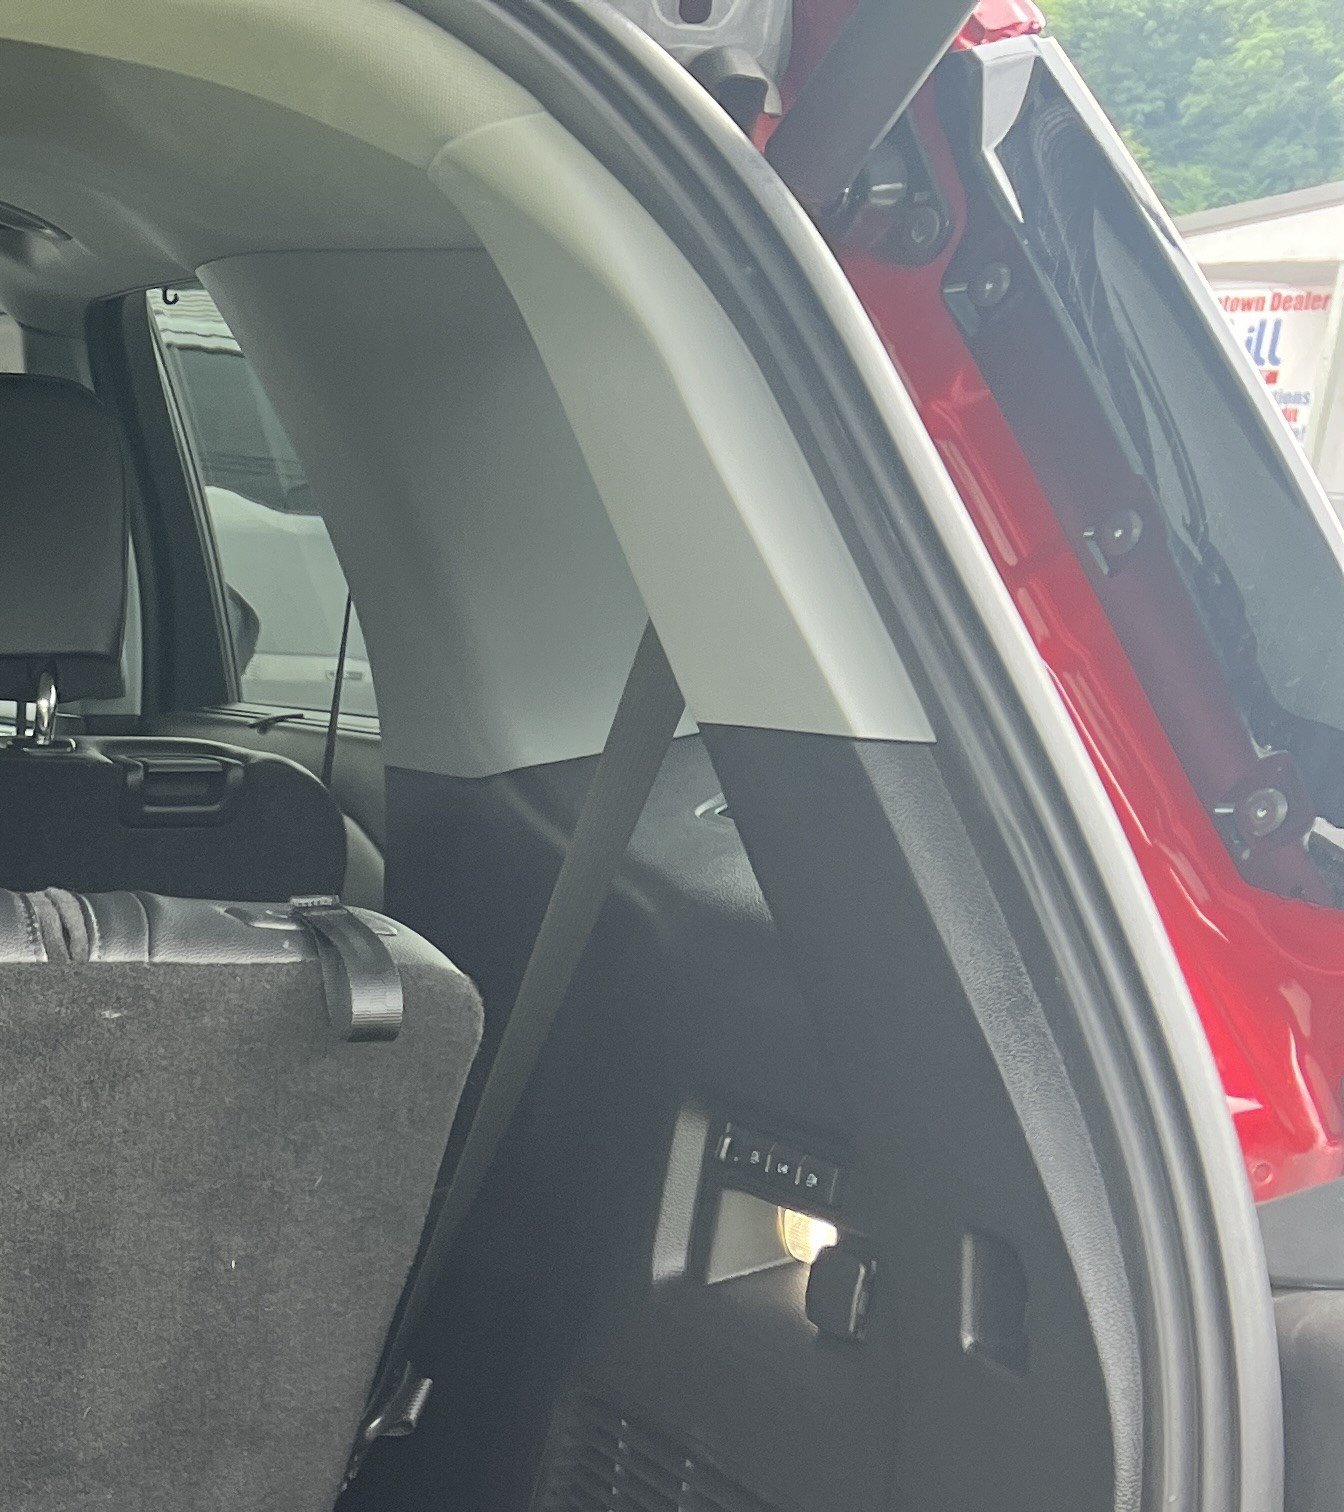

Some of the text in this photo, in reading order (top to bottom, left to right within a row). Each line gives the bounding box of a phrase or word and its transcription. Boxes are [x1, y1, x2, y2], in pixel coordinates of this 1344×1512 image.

[1218, 292, 1332, 312] town Dealer
[1244, 318, 1283, 366] ill
